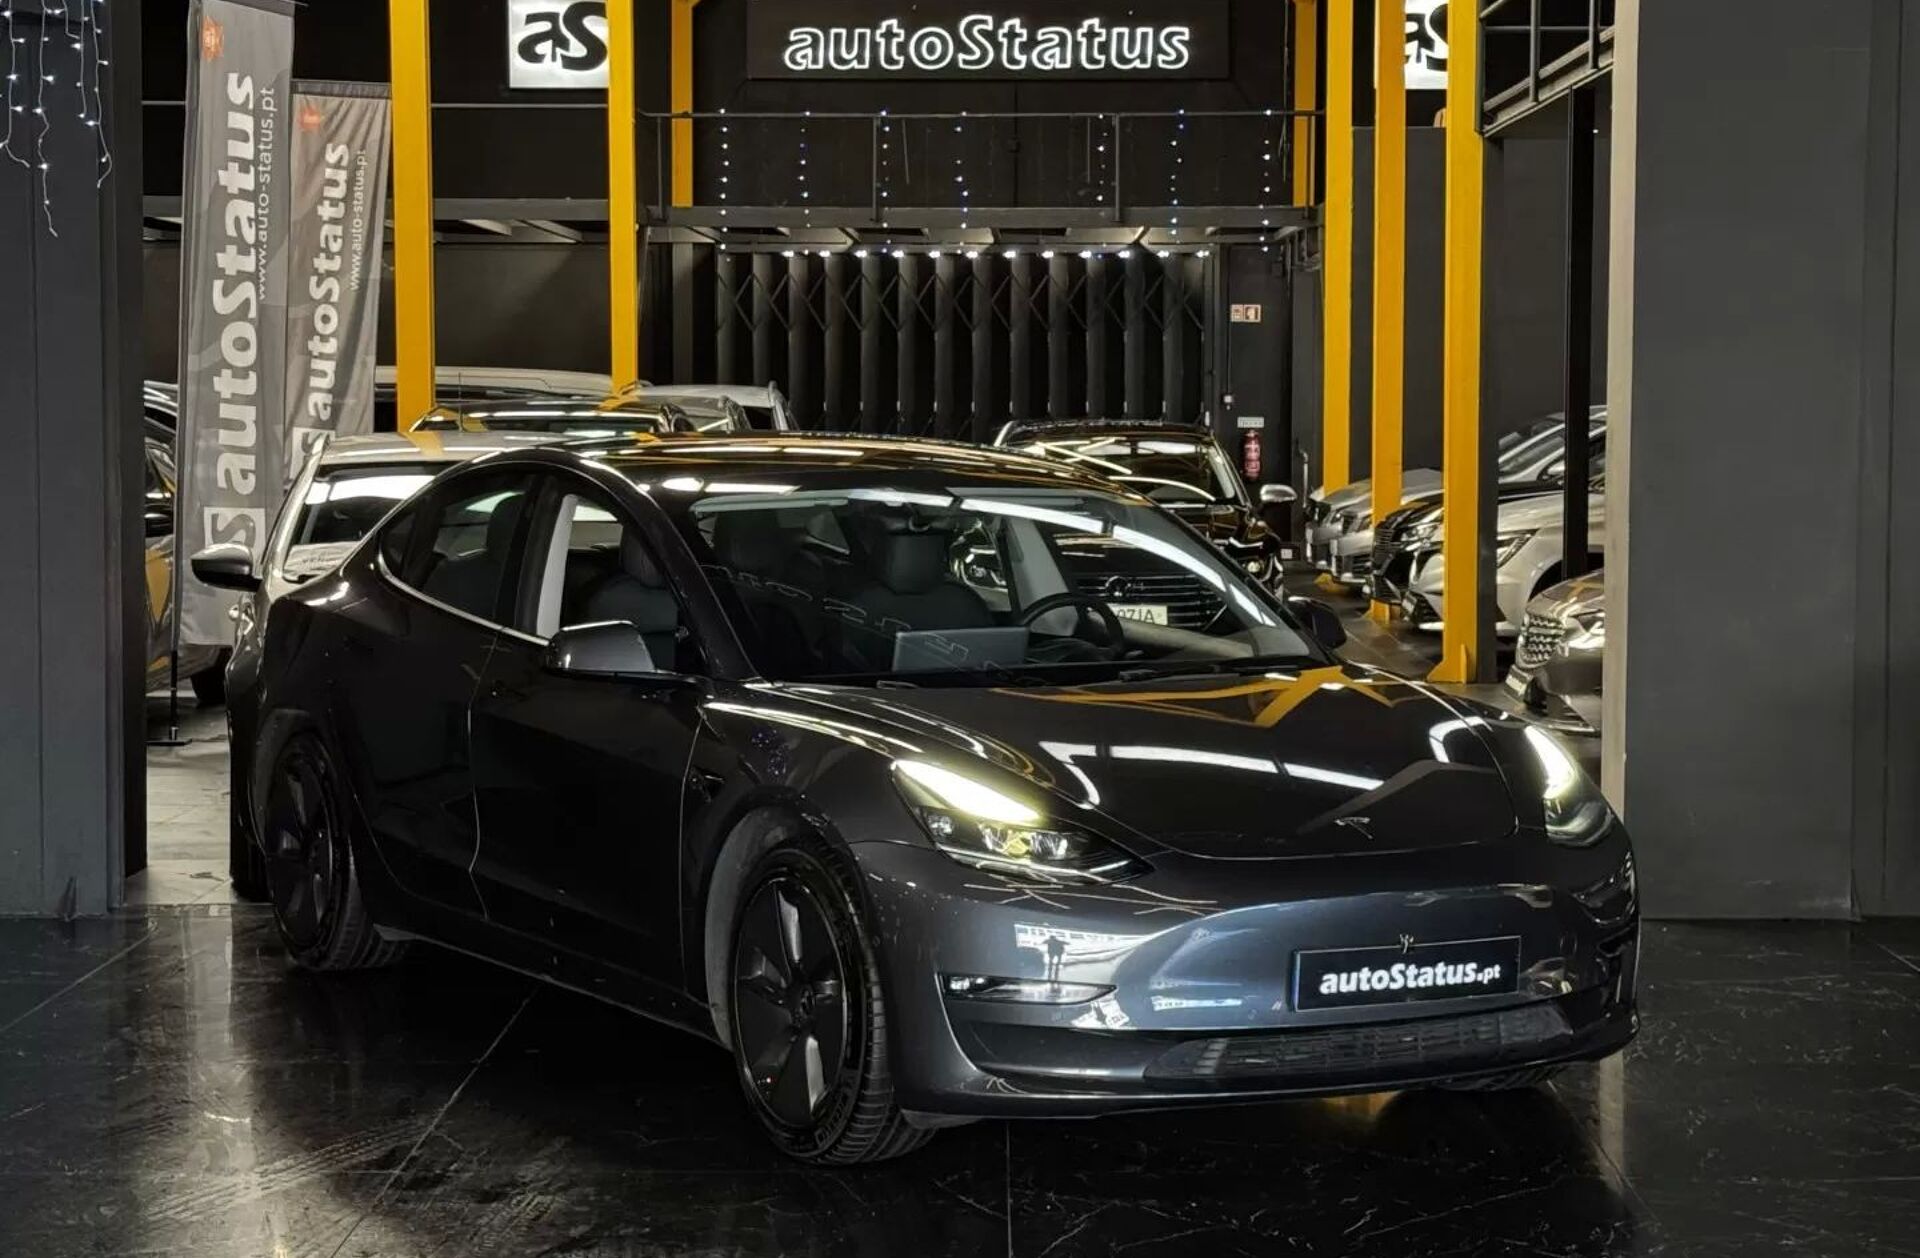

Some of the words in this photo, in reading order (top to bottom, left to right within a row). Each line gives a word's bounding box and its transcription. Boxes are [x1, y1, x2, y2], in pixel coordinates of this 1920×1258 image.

[783, 14, 1190, 70] autoStatus
[213, 72, 257, 495] autoStatus
[258, 87, 277, 300] www.auto-status.pt
[308, 143, 349, 421] autoStatus
[1318, 961, 1501, 995] autoStatus.pt
